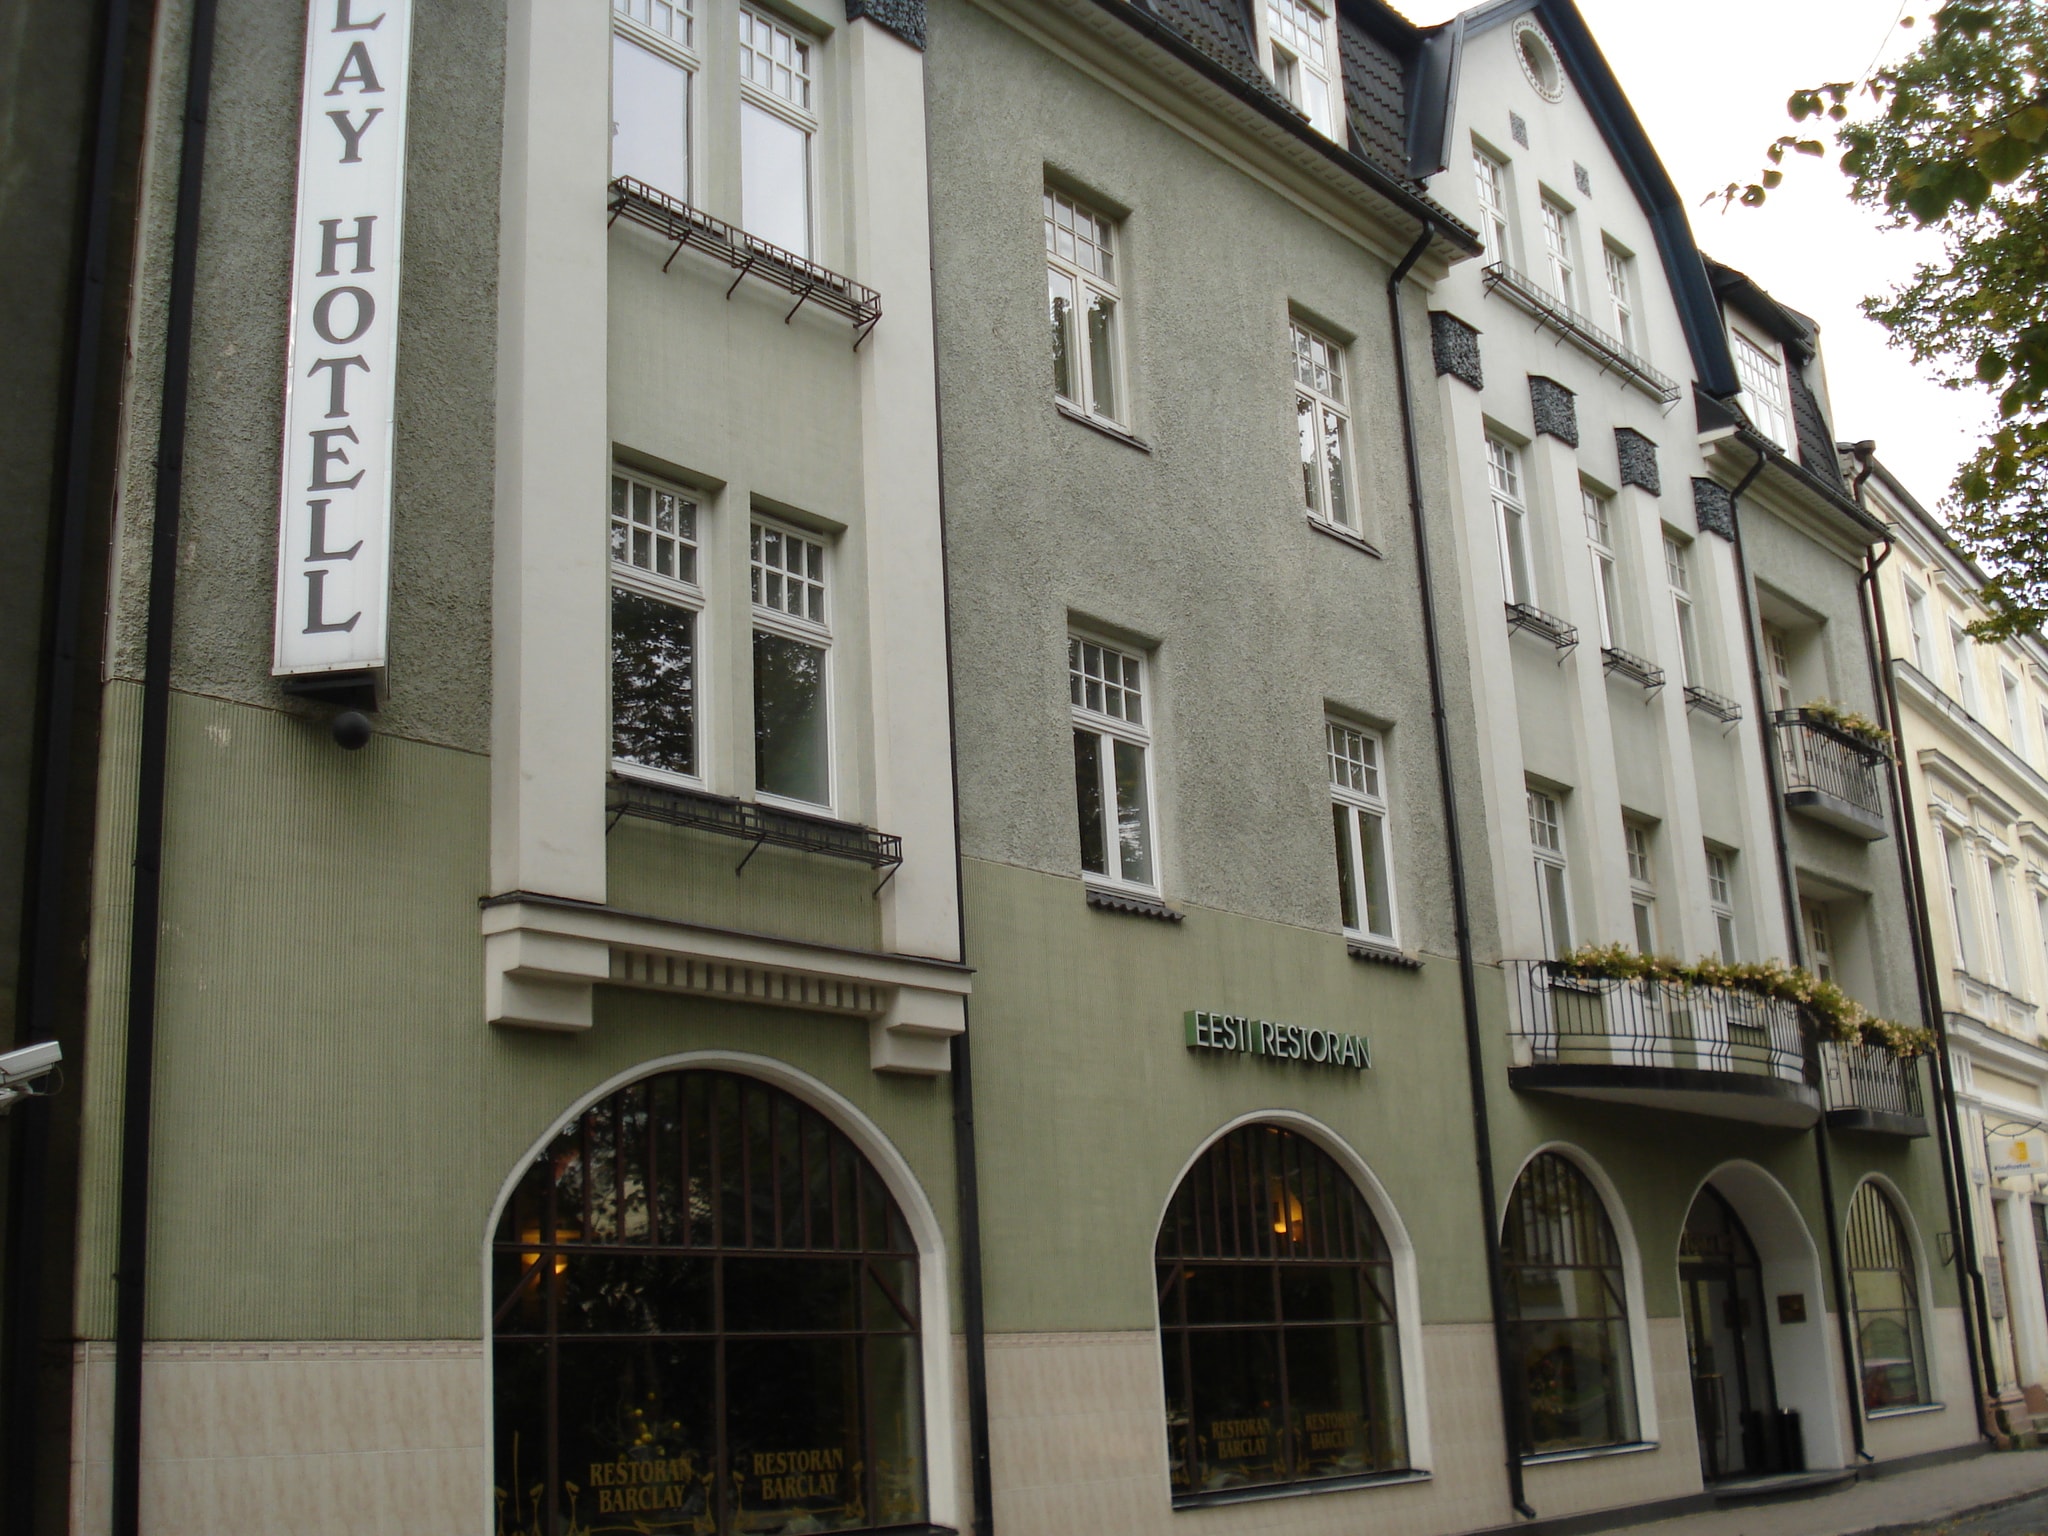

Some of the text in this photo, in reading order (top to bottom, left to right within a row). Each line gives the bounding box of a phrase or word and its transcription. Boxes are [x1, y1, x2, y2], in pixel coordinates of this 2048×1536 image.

[302, 0, 386, 635] LAY HOTELL
[1192, 1010, 1372, 1069] EESTI RESTORAN
[1212, 1418, 1270, 1439] RESTORAN
[752, 1448, 844, 1476] RESTORAN
[1218, 1437, 1267, 1460] BARCLAY
[589, 1457, 693, 1487] RESTORAN
[761, 1472, 838, 1501] BARCLAY
[599, 1485, 685, 1514] BARCLAY
